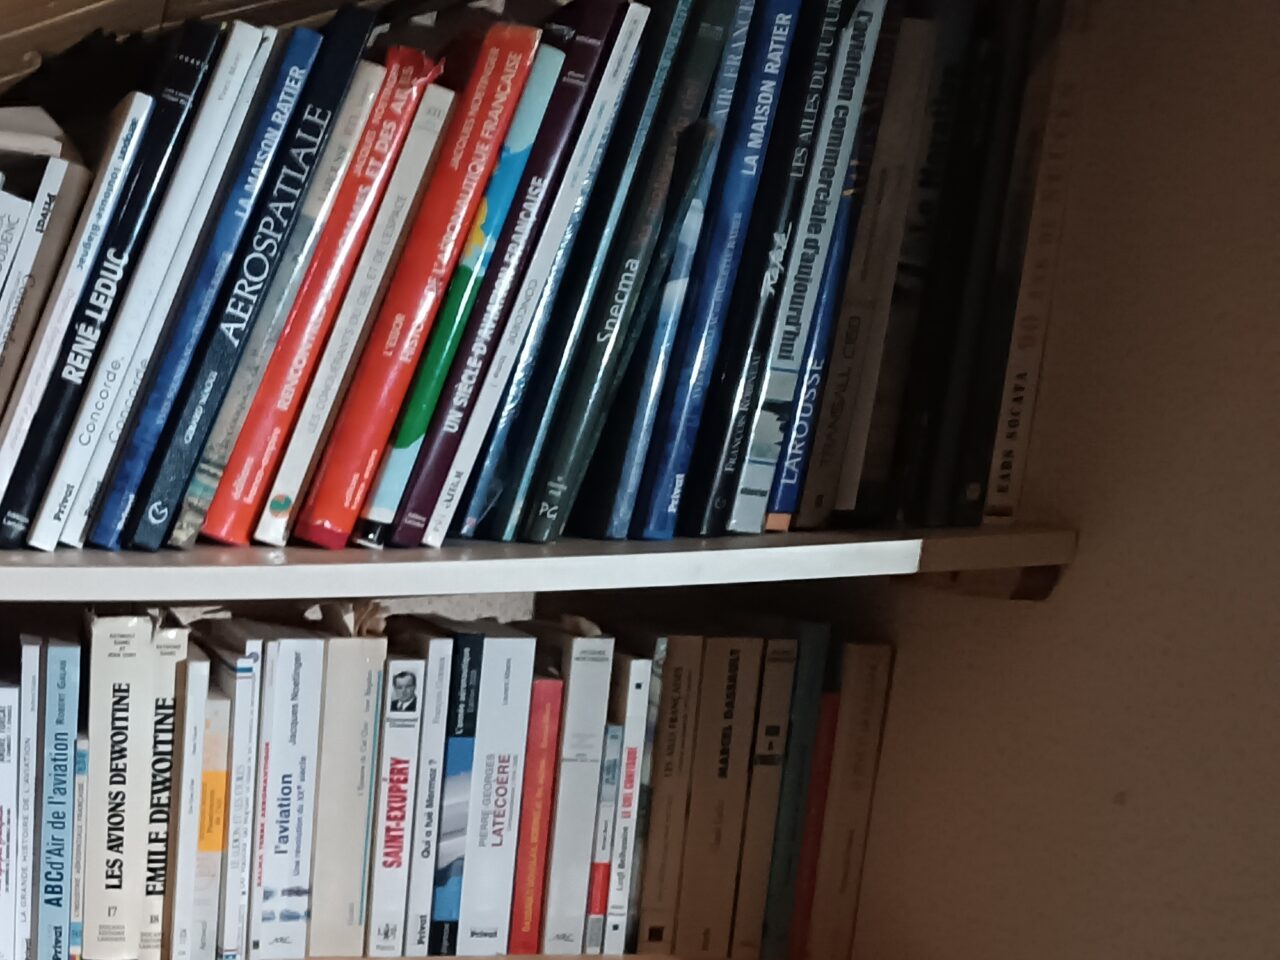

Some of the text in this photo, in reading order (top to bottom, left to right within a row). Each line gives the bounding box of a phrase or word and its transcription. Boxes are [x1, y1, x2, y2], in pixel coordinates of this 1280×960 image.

[741, 11, 791, 176] LA MAISON RATIER
[809, 62, 827, 90] DU
[244, 125, 281, 194] MAISON
[270, 64, 305, 126] RATIER
[798, 91, 821, 142] AILES
[790, 146, 809, 179] LES
[806, 103, 850, 235] commerciale
[34, 192, 56, 234] Privat
[213, 101, 332, 348] AEROSPATIALE
[60, 245, 130, 385] RENÉ LEDUC
[382, 311, 405, 358] L'ESSOR
[505, 276, 539, 346] CONCORDE
[596, 254, 639, 346] Snecma
[775, 236, 820, 362] d'aujourd'hui
[106, 356, 149, 444] Concorde
[452, 355, 481, 407] SIÈCLE
[443, 407, 463, 433] UN
[782, 355, 825, 486] LAROUSSE
[996, 369, 1028, 494] EADS SOCATA
[52, 482, 75, 522] Privat
[668, 471, 685, 514] Privat
[287, 703, 300, 746] Jacques
[43, 732, 69, 906] ABCd'Air de l'aviation
[105, 683, 129, 890] LES AVIONS DEWOITINE
[146, 695, 175, 897] EMILE DEWOITINE
[273, 772, 292, 855] l'aviation
[383, 757, 409, 870] SAINT-EXUPÉRY
[424, 810, 433, 827] tué
[425, 768, 437, 808] Mermoz
[478, 753, 495, 847] PIERRE GEORGES
[19, 737, 31, 922] LA GRANDE HISTOIRE DE L'AVIATION
[421, 840, 431, 858] Qui
[51, 925, 62, 960] Privat
[108, 906, 117, 917] 17
[416, 914, 427, 944] Privat
